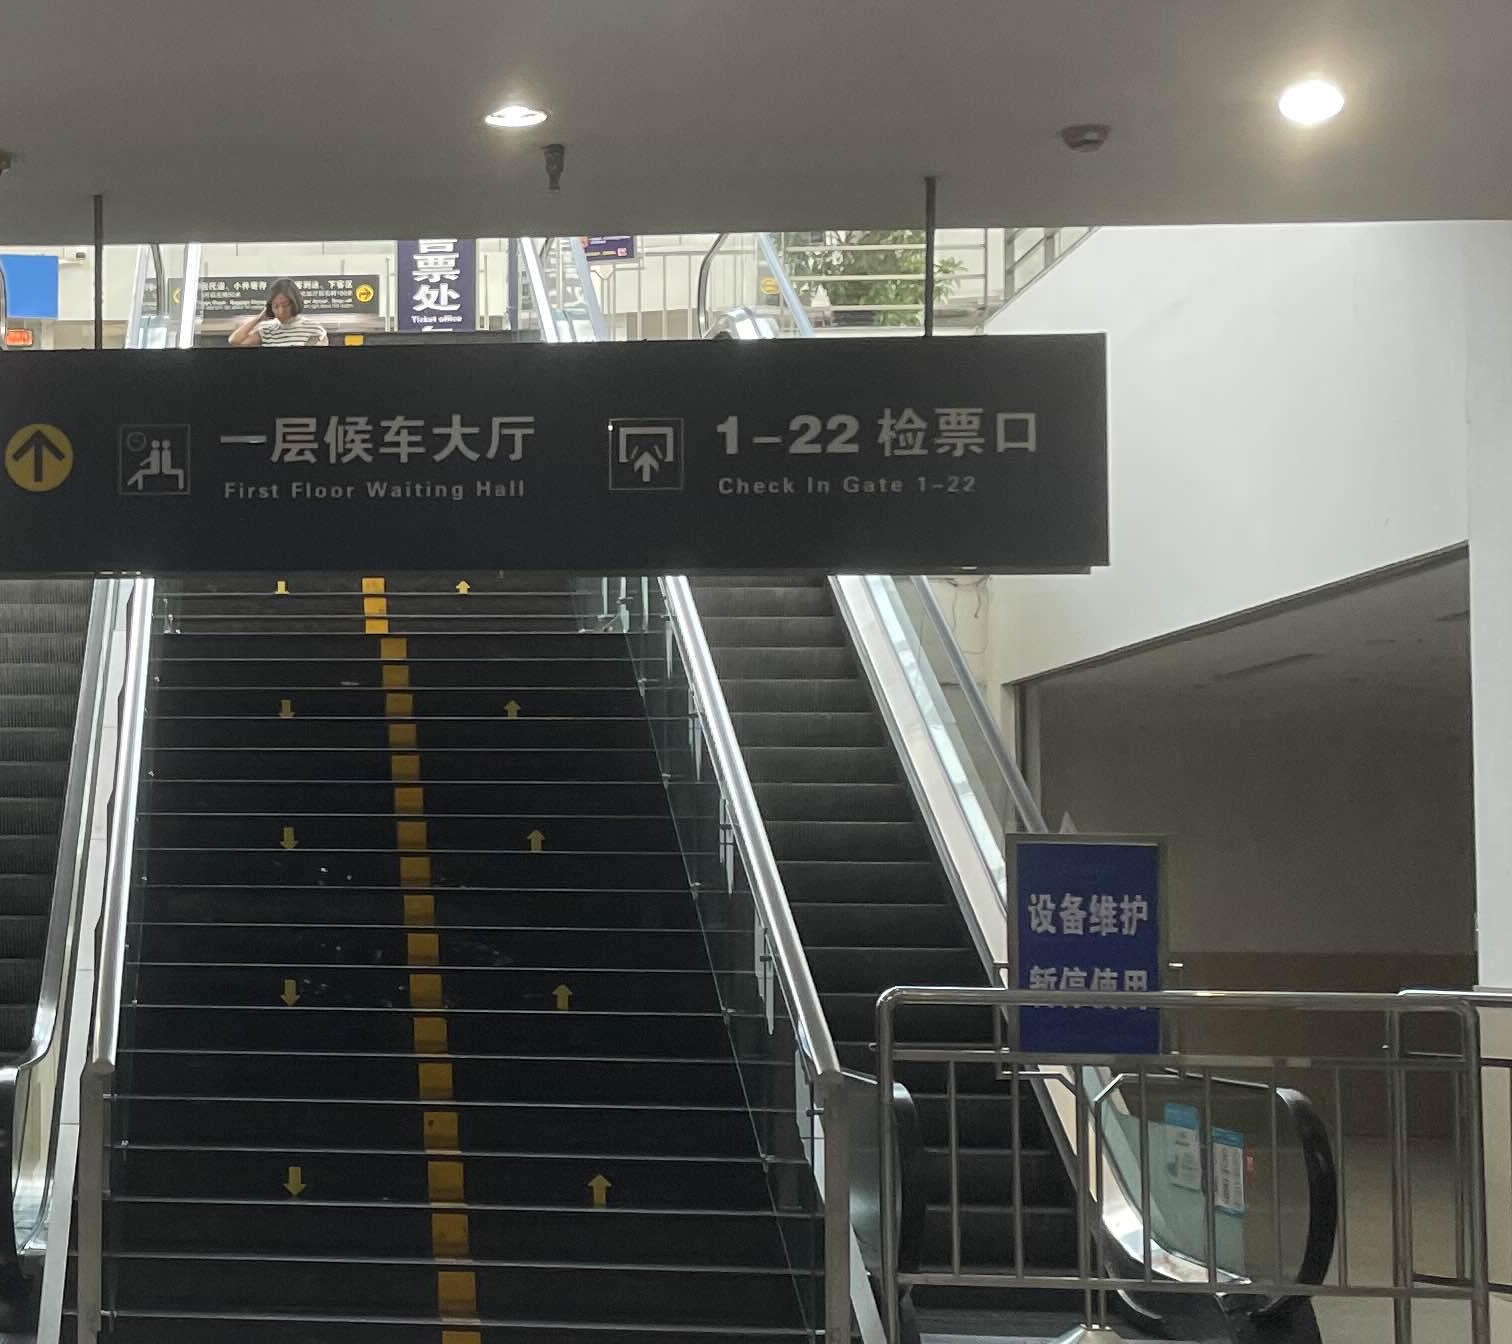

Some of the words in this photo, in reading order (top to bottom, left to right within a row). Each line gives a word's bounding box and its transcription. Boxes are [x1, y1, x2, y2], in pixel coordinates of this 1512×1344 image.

[411, 315, 437, 324] Ticket
[438, 315, 463, 324] office
[220, 413, 535, 463] 一层候车大厅
[716, 414, 860, 455] 1-22
[878, 408, 1037, 456] 检票口
[224, 482, 279, 498] First
[291, 482, 354, 499] Floor
[366, 481, 464, 500] Waiting
[475, 480, 525, 497] Hall
[718, 477, 794, 495] Check
[807, 477, 830, 494] In
[842, 476, 903, 494] Gate
[917, 476, 976, 493] 1-22
[1028, 893, 1149, 936] 设备维护
